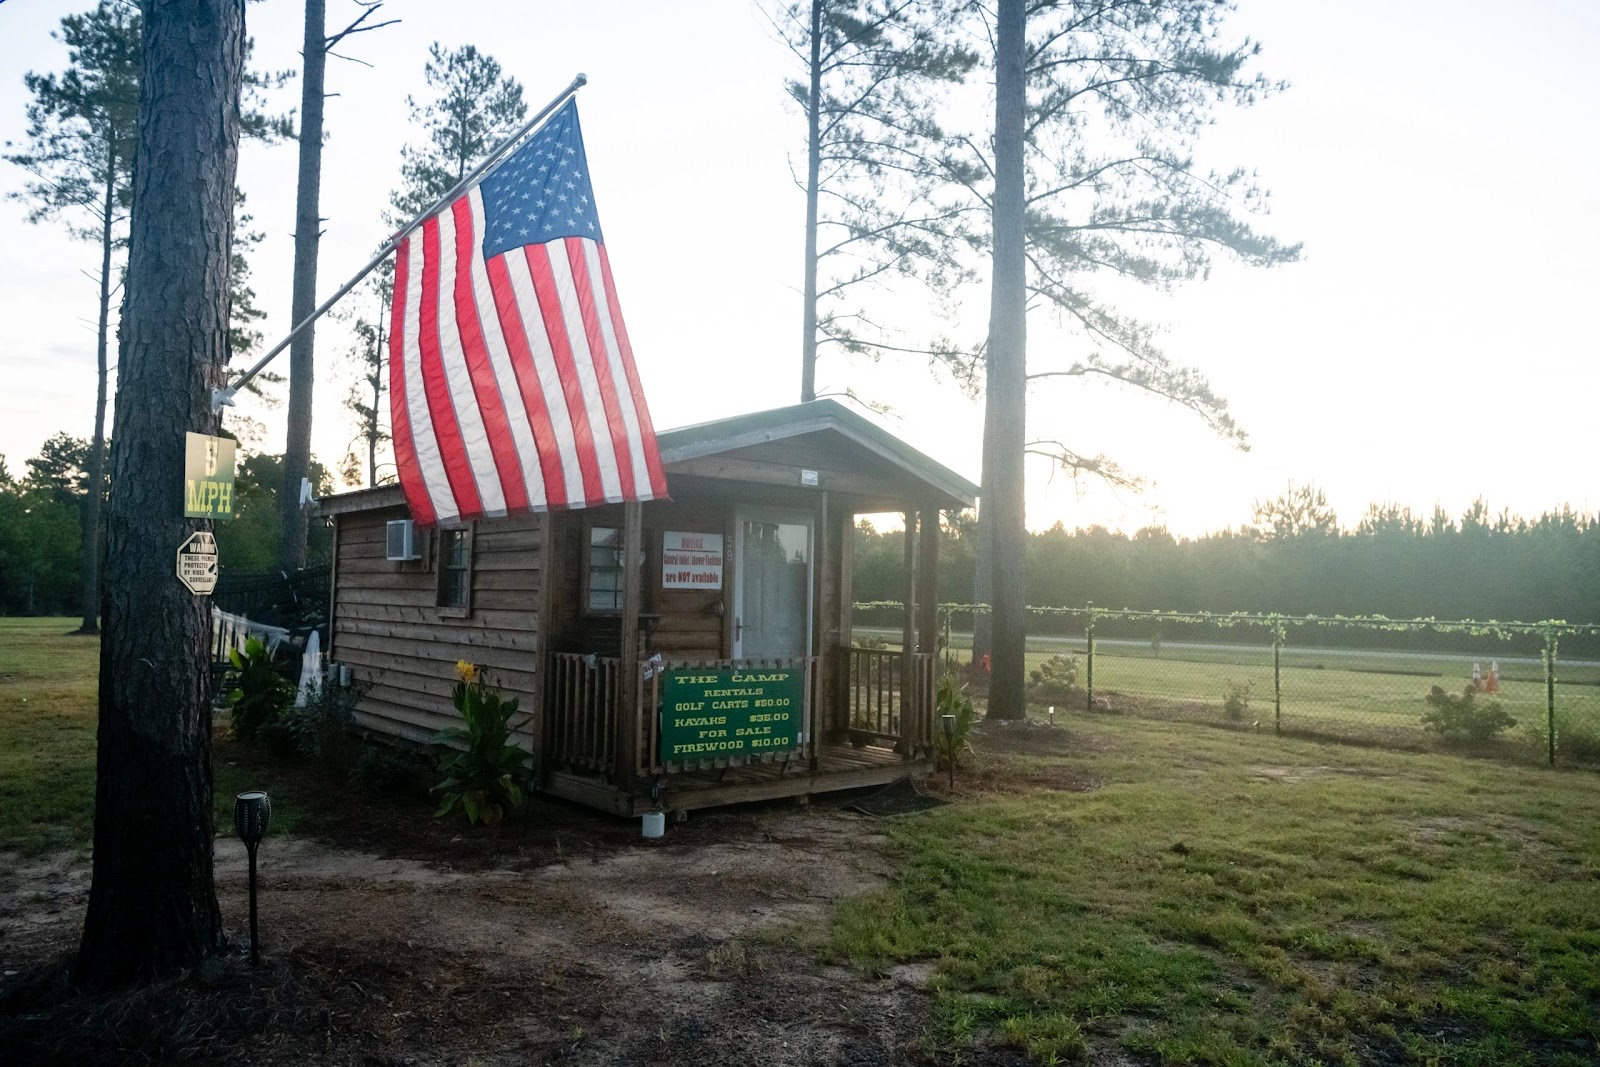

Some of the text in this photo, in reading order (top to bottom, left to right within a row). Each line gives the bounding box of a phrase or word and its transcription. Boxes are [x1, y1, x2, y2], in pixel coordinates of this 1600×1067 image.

[205, 440, 218, 477] 5
[187, 479, 232, 513] MPH
[681, 537, 704, 549] NOTICE
[666, 571, 719, 583] are NOT available
[675, 673, 790, 684] THE CAMP
[704, 688, 764, 697] RENTALS
[675, 698, 790, 711] GOLF CARTS $50.00
[675, 713, 789, 727] KAYAKS $35.00
[699, 726, 772, 739] FOR SALE
[673, 737, 789, 754] FIREWOOD $10.00
